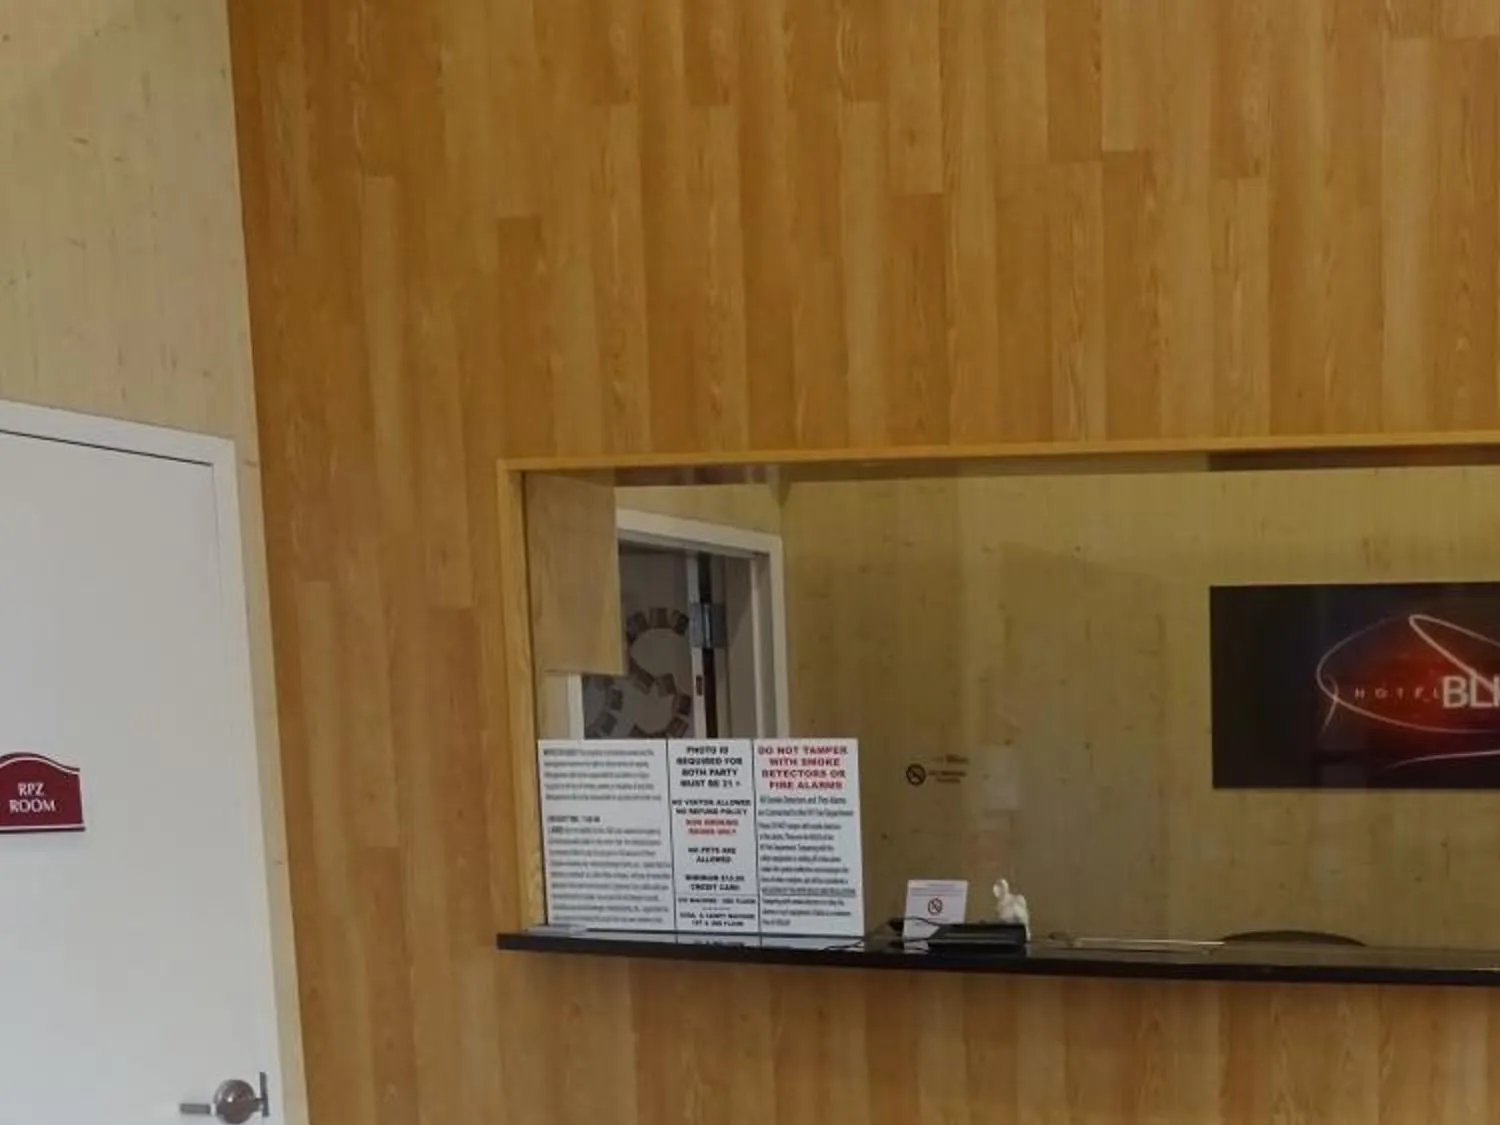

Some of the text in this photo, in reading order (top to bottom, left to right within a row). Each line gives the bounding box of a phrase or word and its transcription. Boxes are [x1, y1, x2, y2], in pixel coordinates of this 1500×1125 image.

[758, 745, 848, 755] DO NOT TAMPER
[676, 757, 743, 766] REQUIRED FOR
[769, 758, 840, 767] WITH SMOKE
[681, 768, 738, 777] BOTH PARTY
[761, 769, 846, 778] DETECTORS OR
[680, 779, 706, 788] MUST
[769, 781, 843, 790] FIRE ALARMS
[17, 781, 46, 797] RPZ
[8, 799, 57, 813] ROOM
